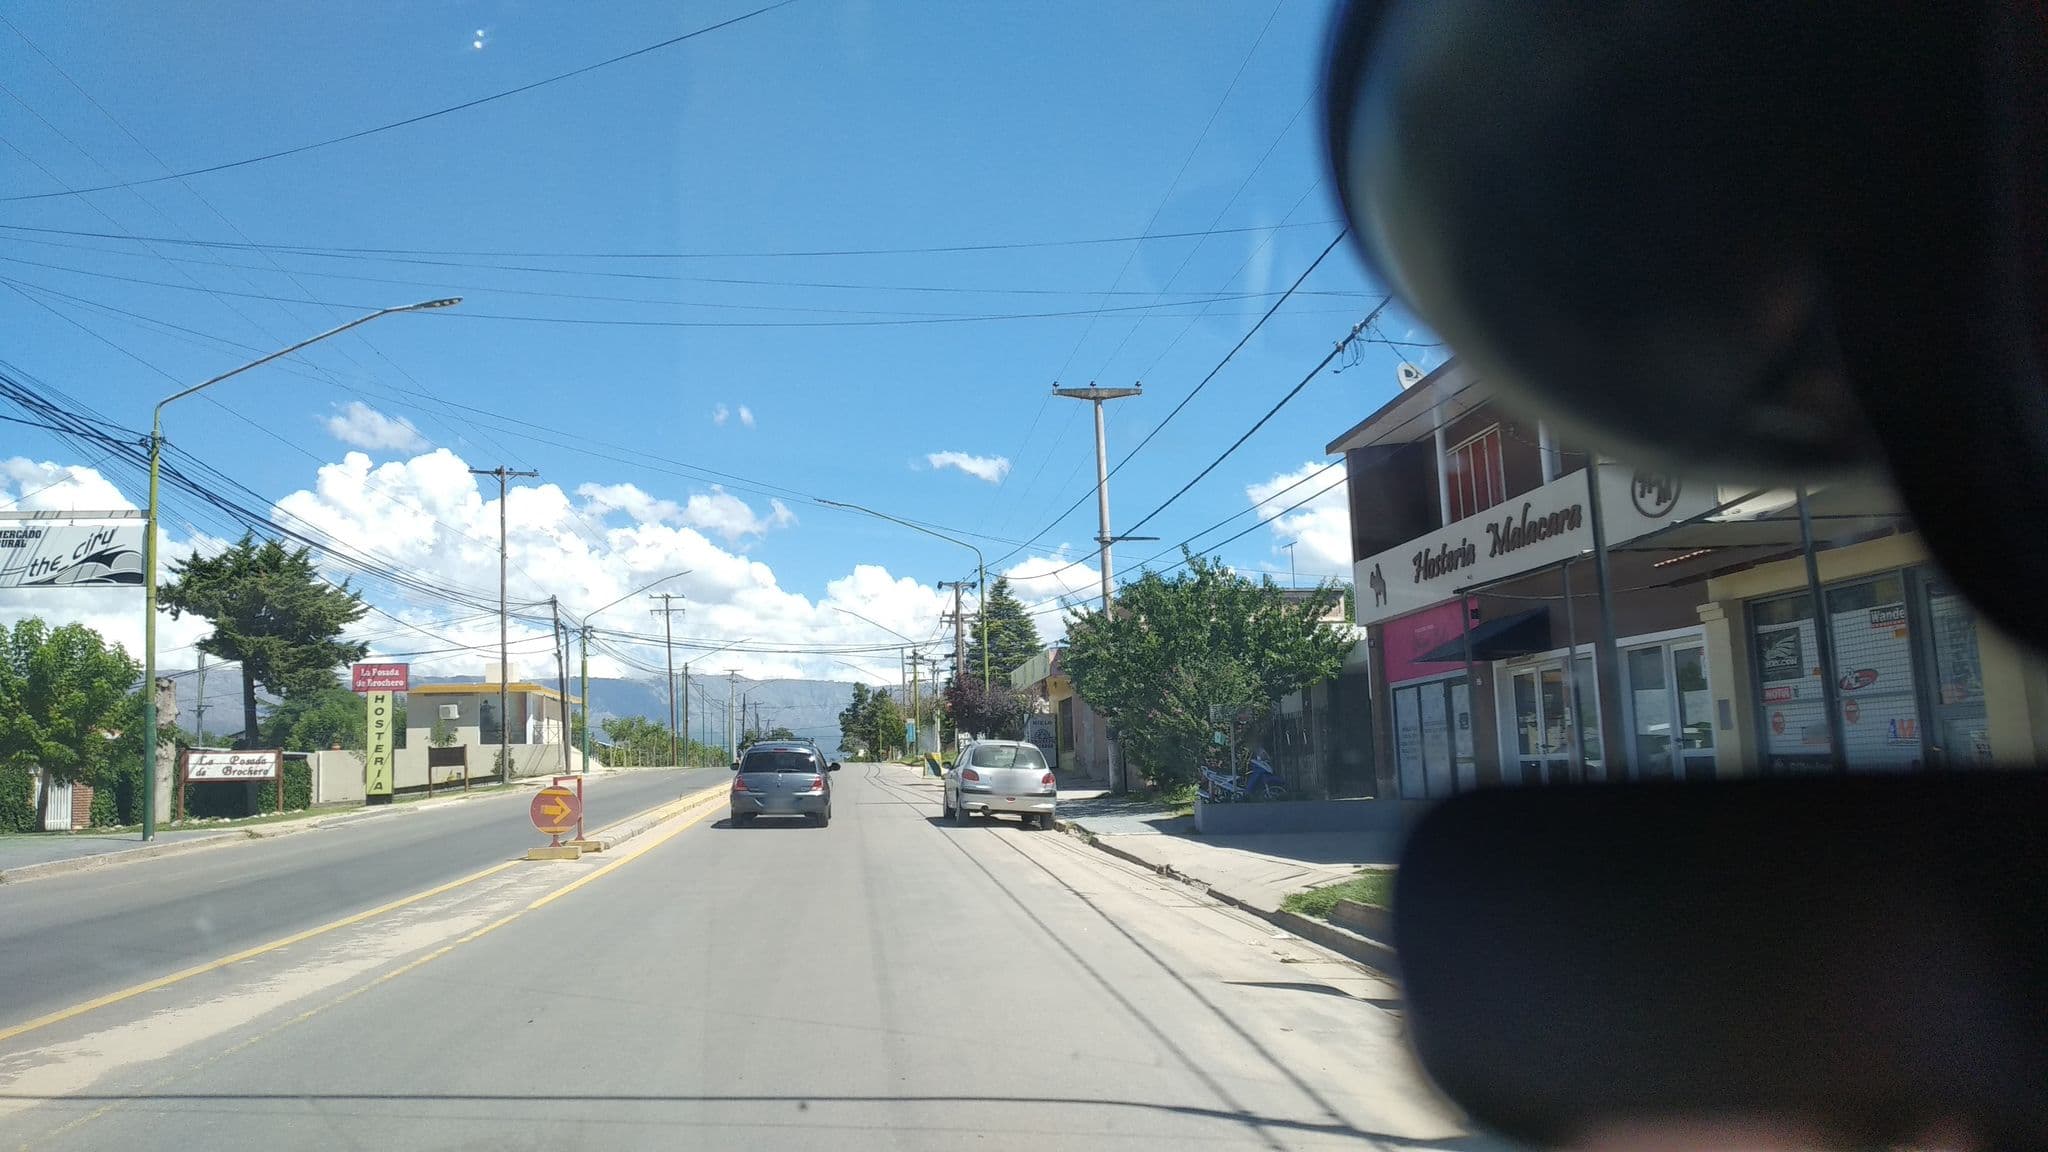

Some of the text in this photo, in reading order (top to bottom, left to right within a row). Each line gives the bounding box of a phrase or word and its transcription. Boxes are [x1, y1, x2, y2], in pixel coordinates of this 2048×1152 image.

[1486, 502, 1582, 557] Malacara
[0, 539, 27, 548] URAL
[374, 695, 385, 790] HOSTERIA
[199, 755, 267, 765] La Posada
[195, 766, 269, 776] de Brochero
